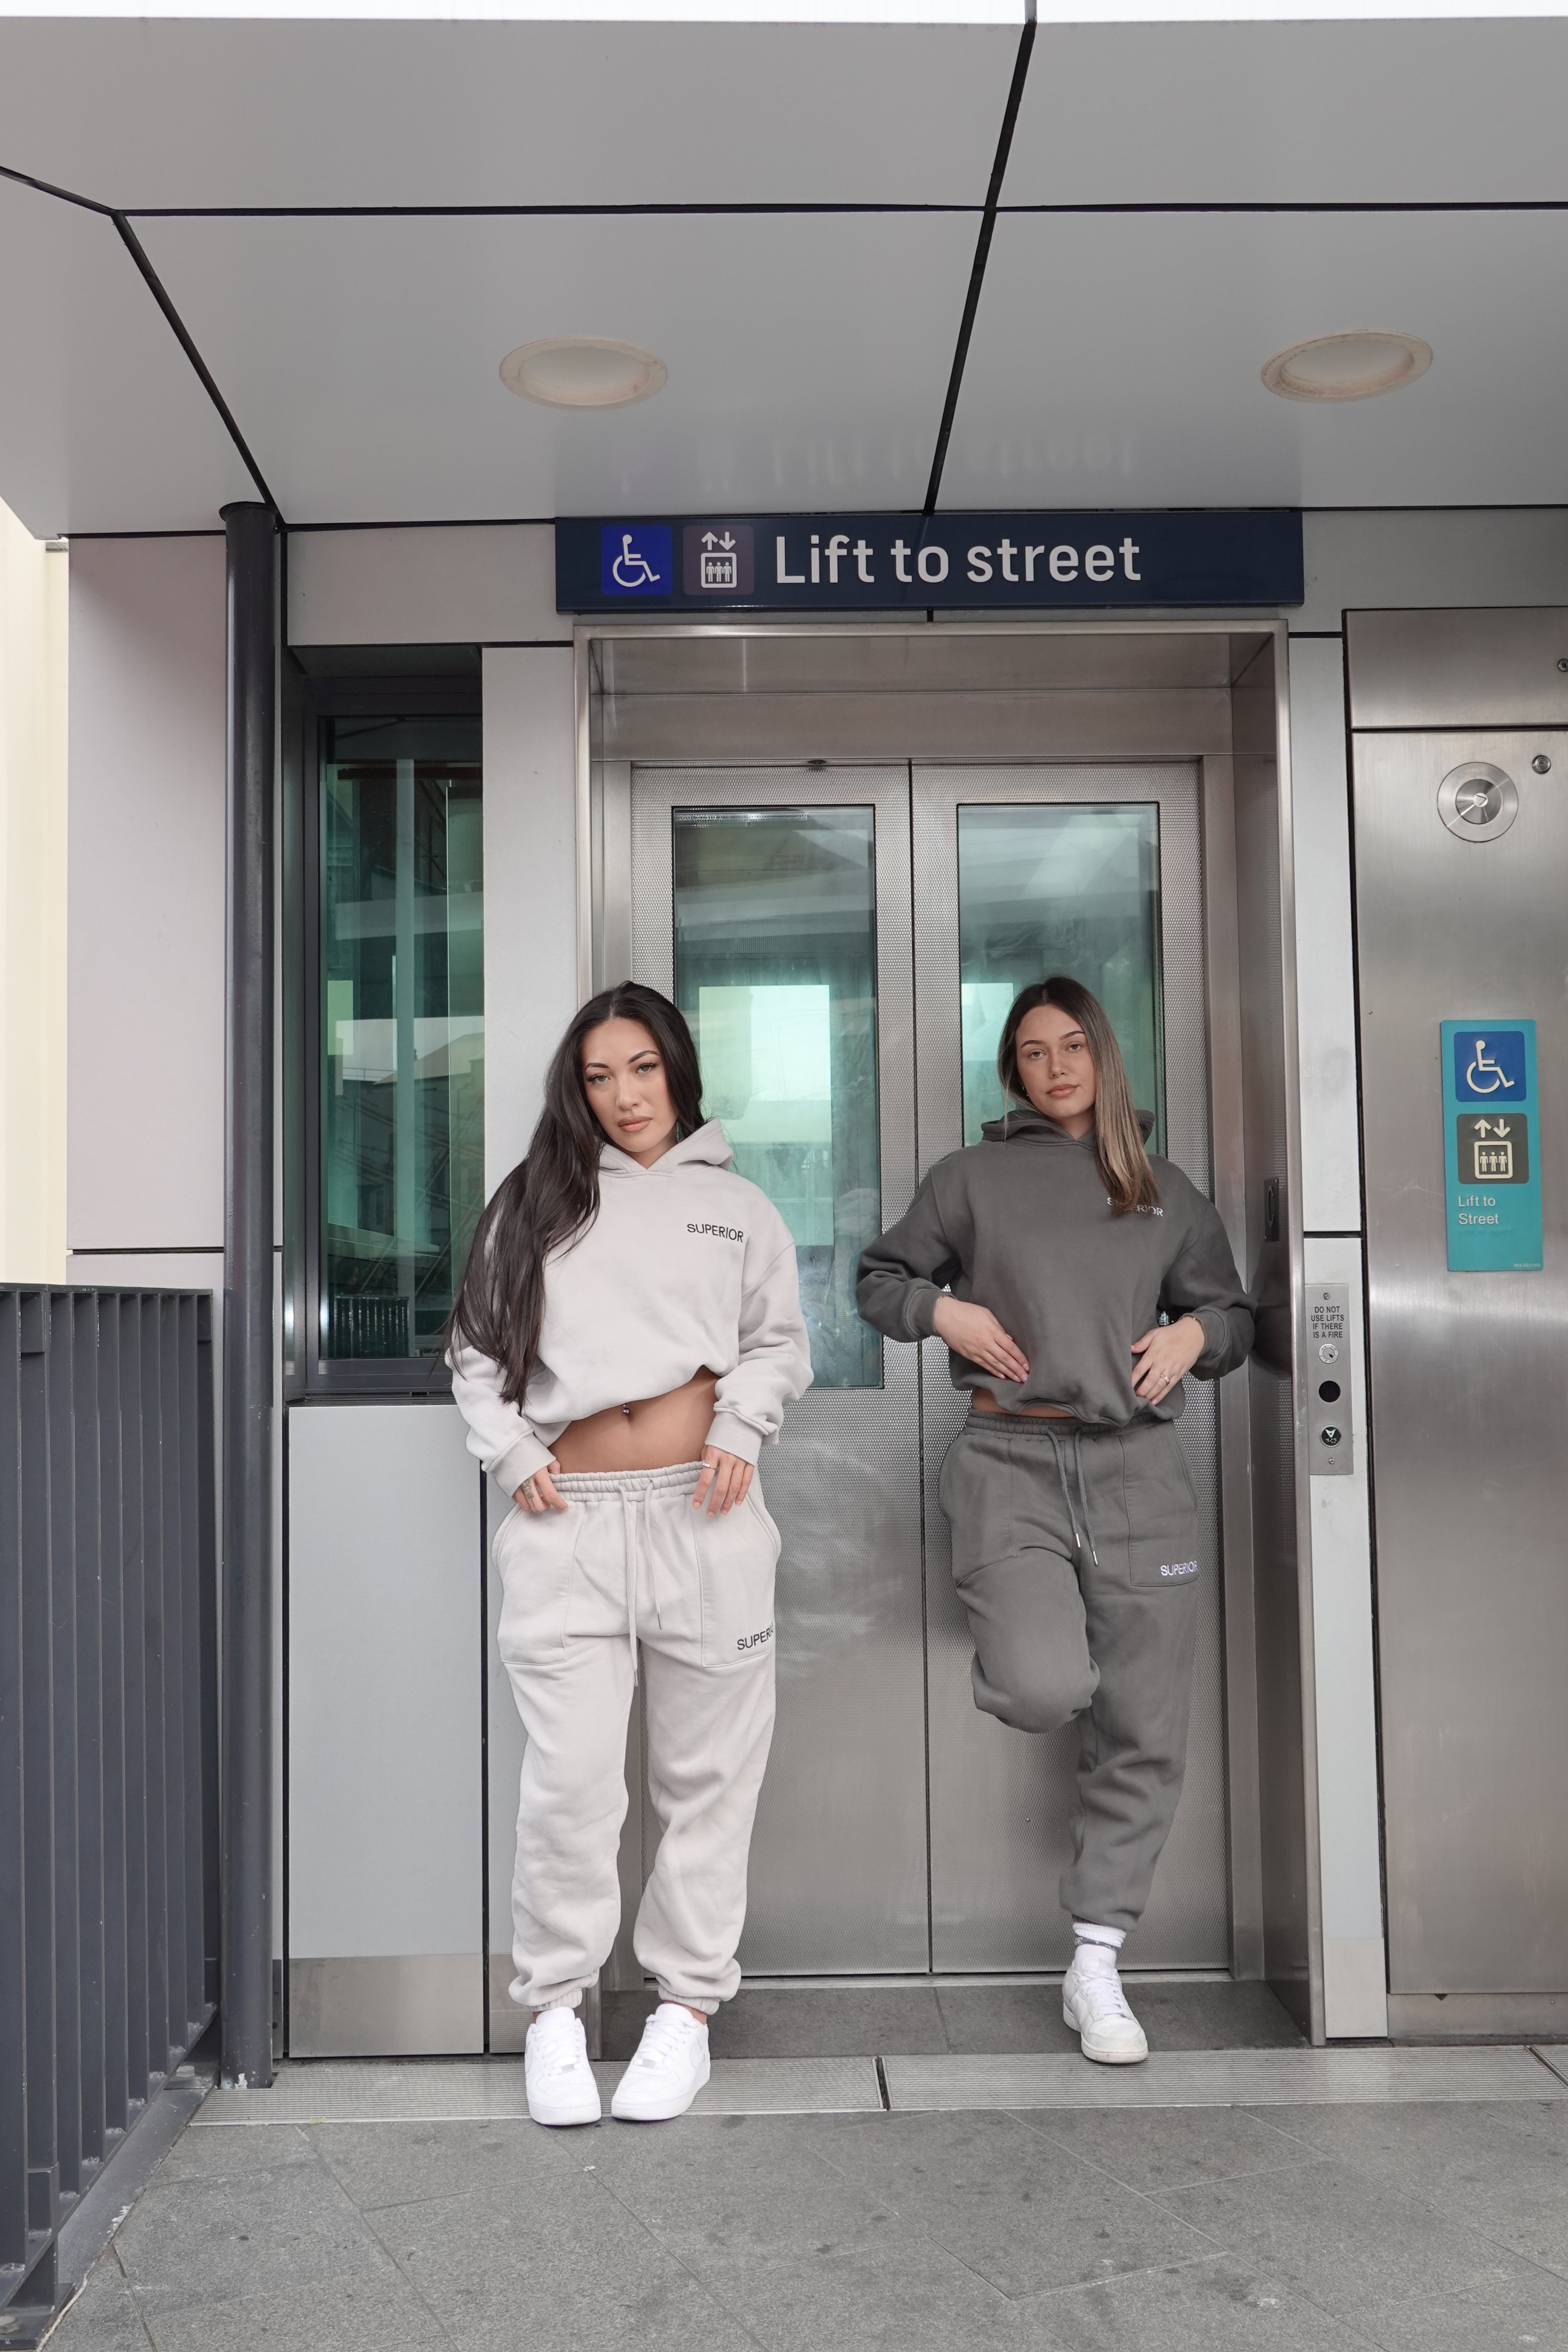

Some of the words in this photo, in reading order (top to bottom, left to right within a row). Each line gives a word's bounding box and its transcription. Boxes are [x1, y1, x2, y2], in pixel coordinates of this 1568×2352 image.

[777, 535, 875, 583] Lift
[891, 540, 949, 583] to
[967, 538, 1141, 583] street
[1458, 1195, 1479, 1207] Lift
[1483, 1196, 1496, 1207] to
[1459, 1213, 1499, 1225] Street
[687, 1224, 744, 1243] SUPERIOR
[1161, 1561, 1198, 1576] SUPERIOR
